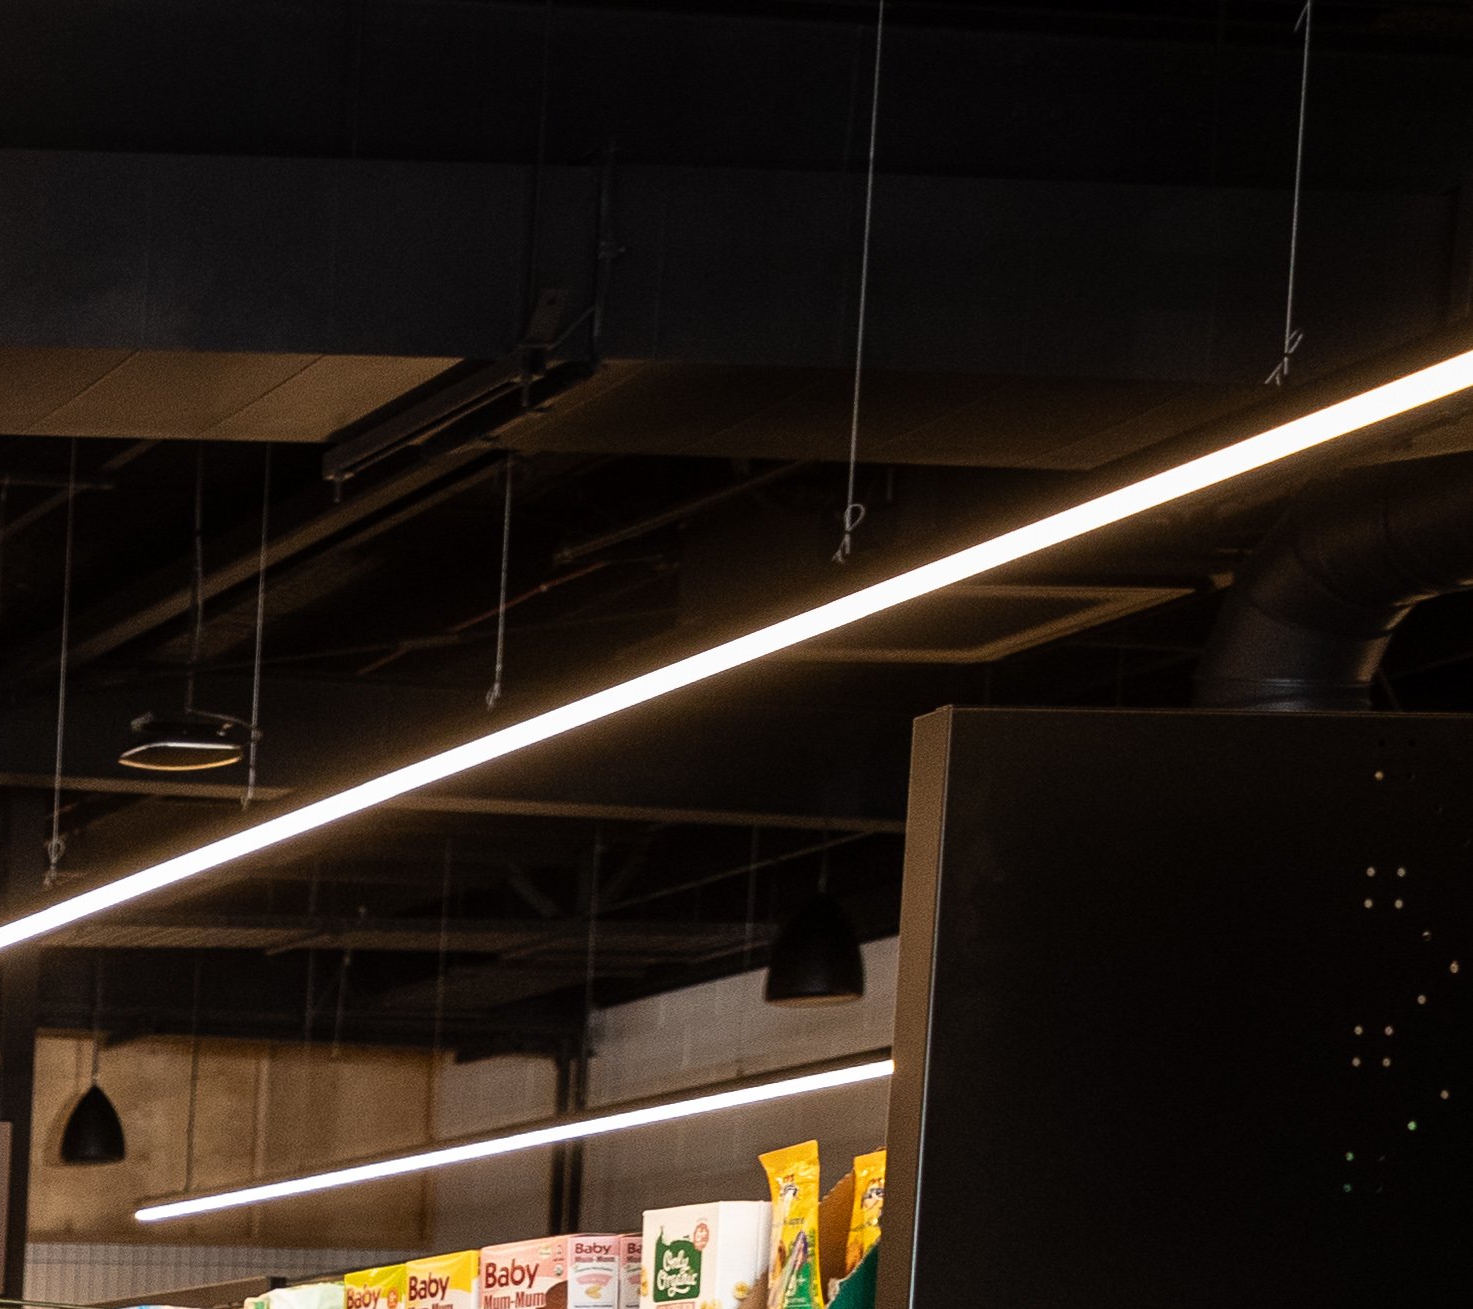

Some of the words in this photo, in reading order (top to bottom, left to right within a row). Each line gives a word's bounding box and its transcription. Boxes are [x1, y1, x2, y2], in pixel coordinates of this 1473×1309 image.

[575, 1242, 612, 1258] Baby
[627, 1242, 642, 1254] Ba
[662, 1248, 690, 1273] Only
[484, 1258, 540, 1289] Baby
[656, 1266, 699, 1298] Organic
[408, 1273, 449, 1301] Baby
